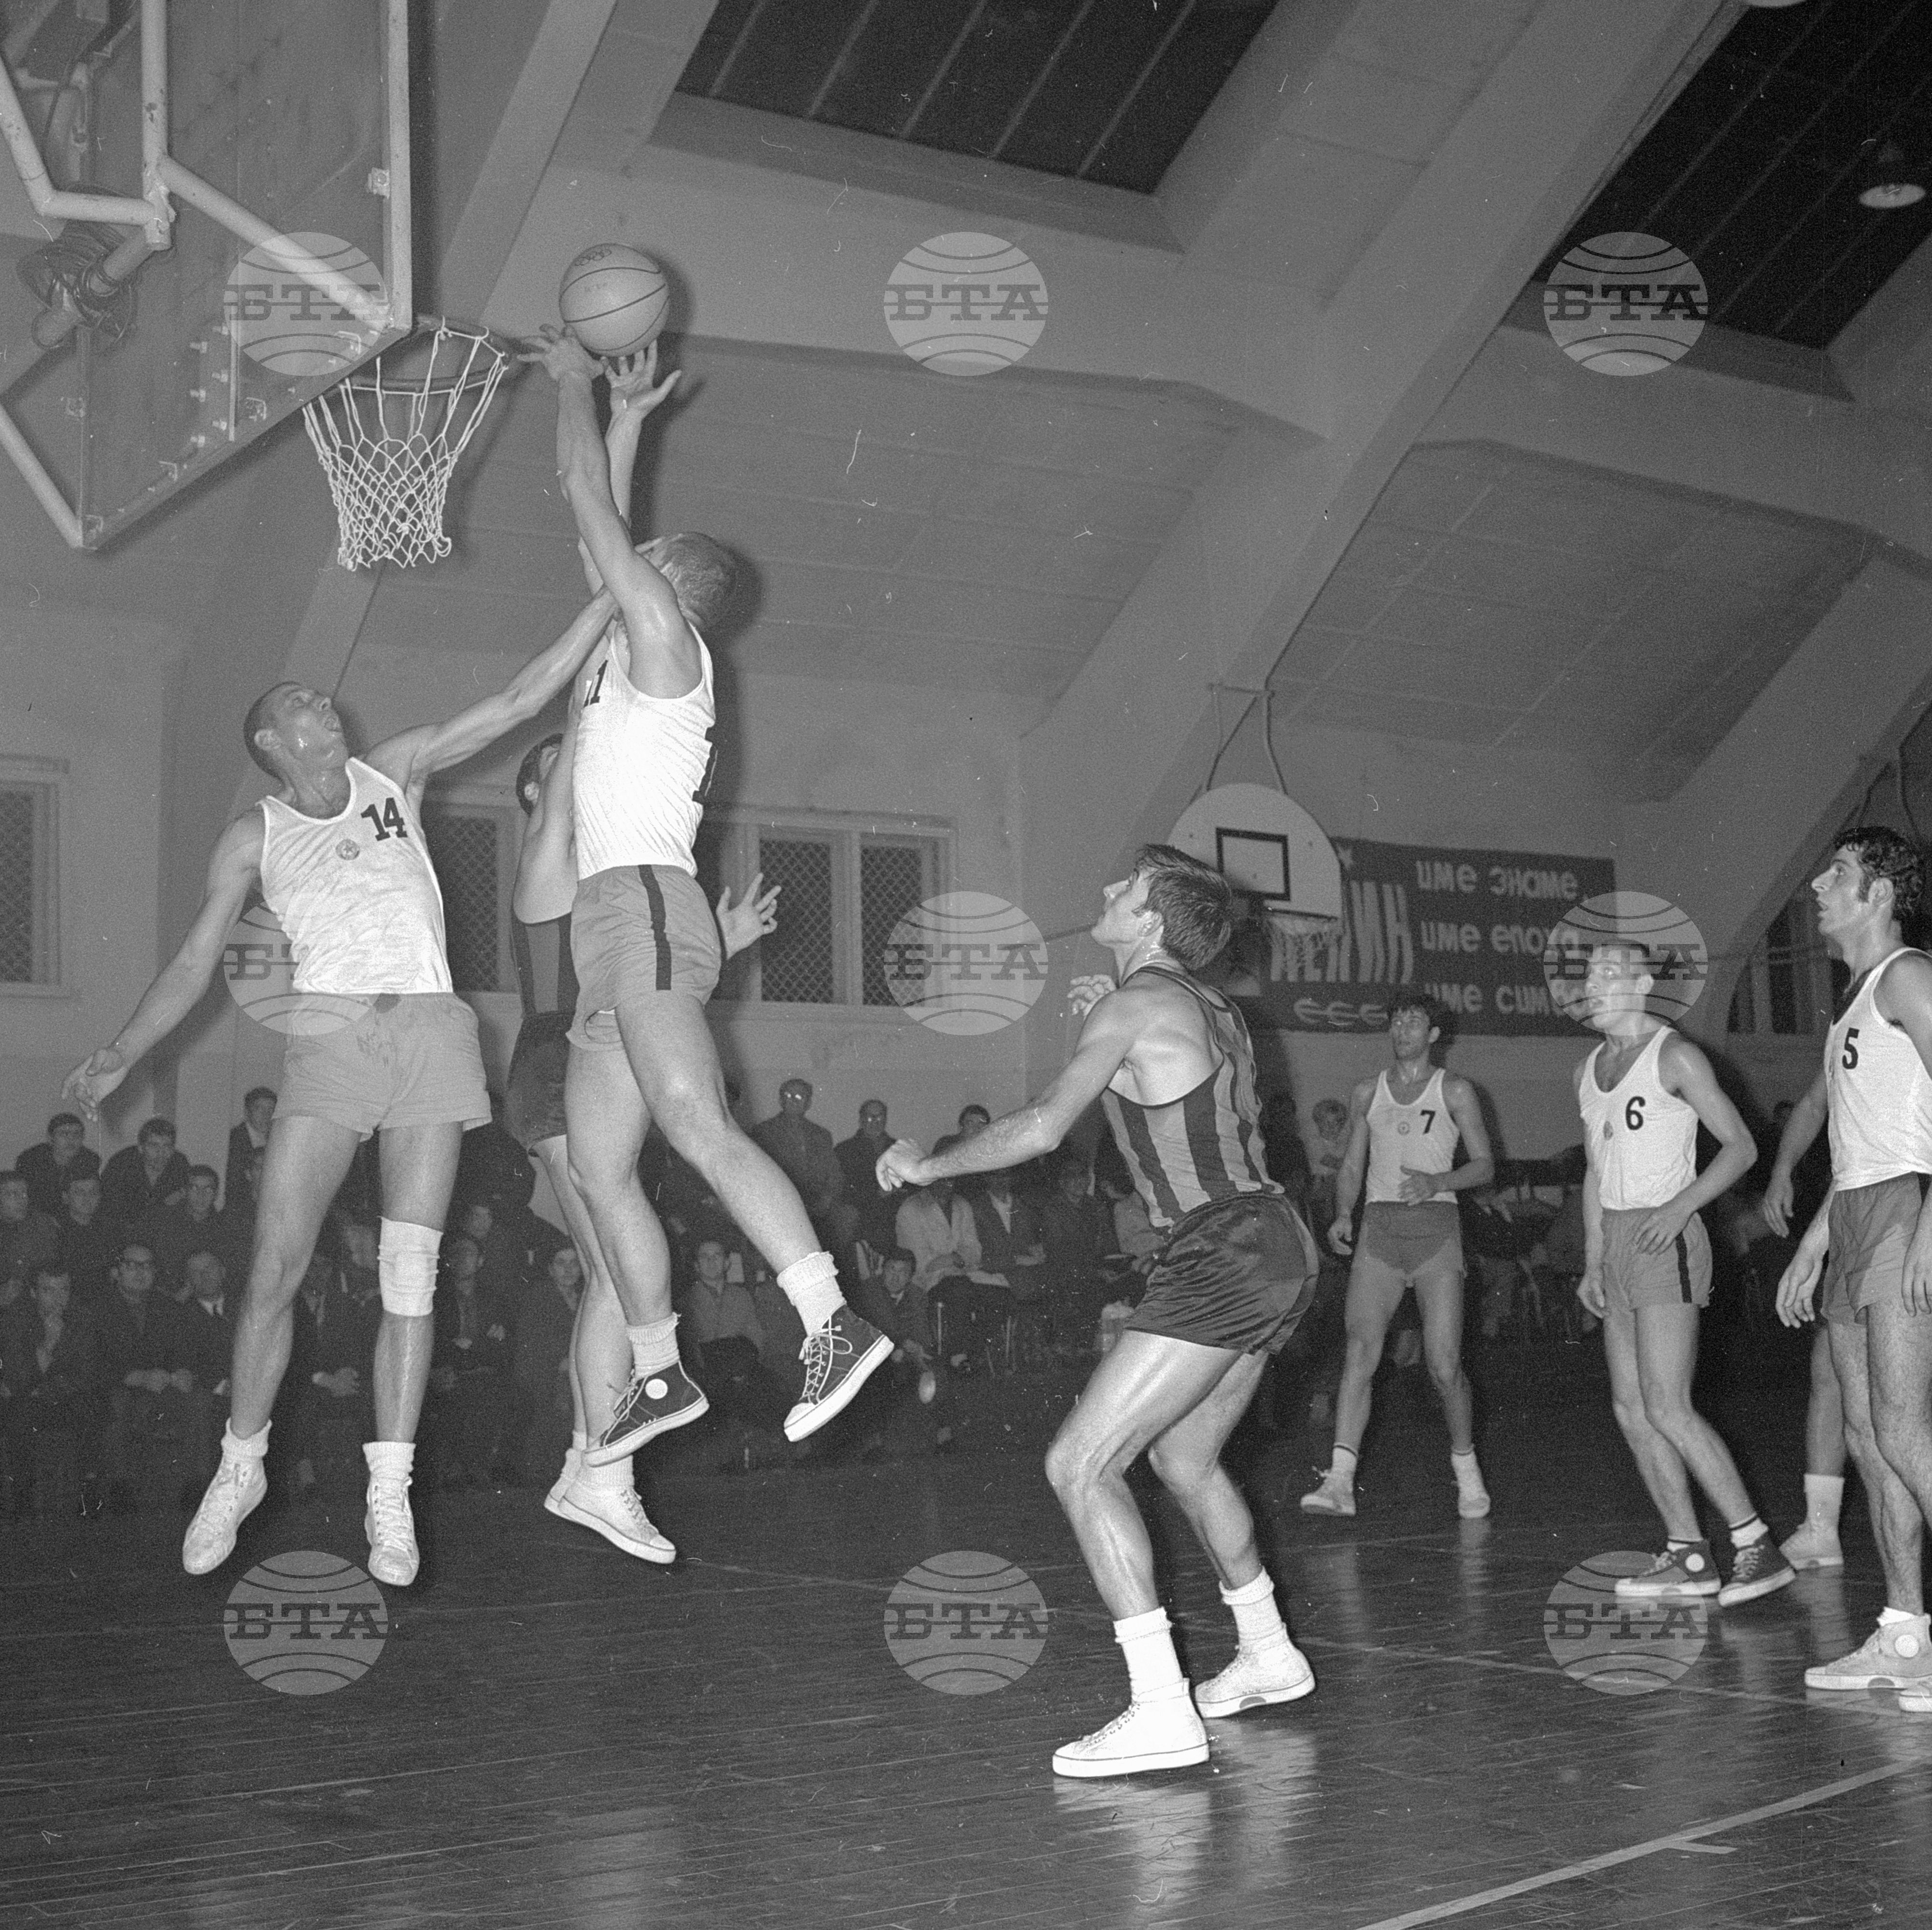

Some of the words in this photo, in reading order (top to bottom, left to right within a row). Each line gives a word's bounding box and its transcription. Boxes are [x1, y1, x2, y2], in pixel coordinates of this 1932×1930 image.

[360, 797, 408, 841] 14
[1842, 1027, 1860, 1070] 5
[1420, 1109, 1436, 1134] 7
[1625, 1096, 1646, 1130] 6
